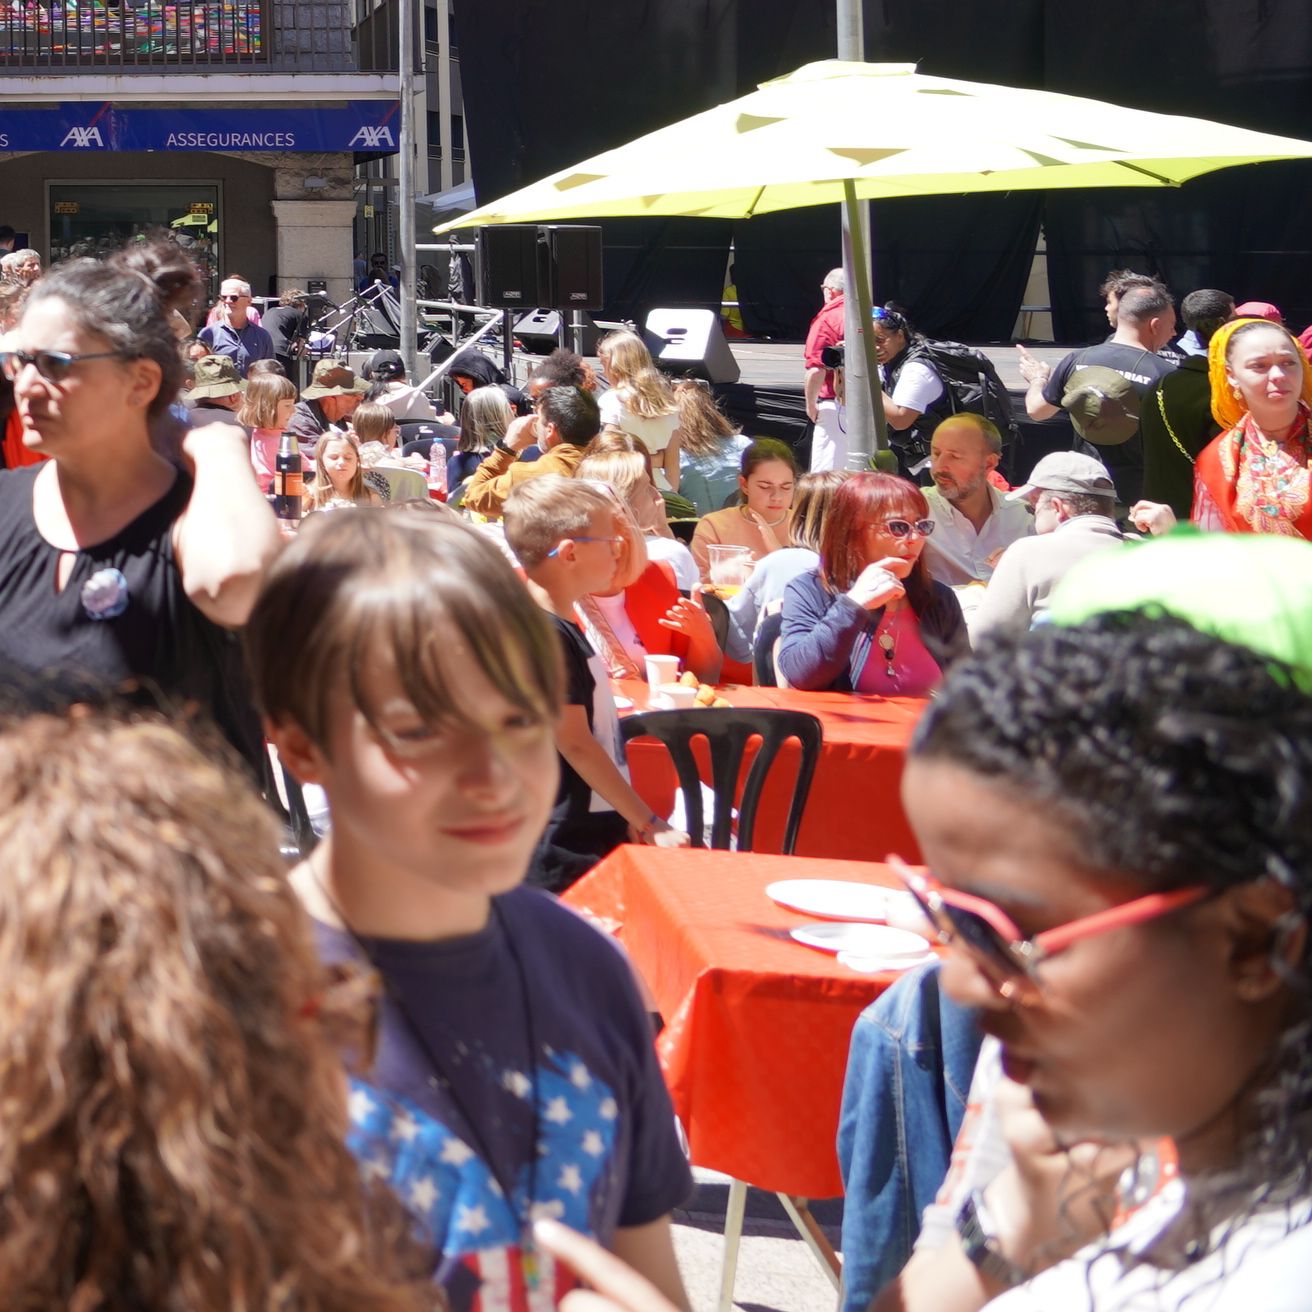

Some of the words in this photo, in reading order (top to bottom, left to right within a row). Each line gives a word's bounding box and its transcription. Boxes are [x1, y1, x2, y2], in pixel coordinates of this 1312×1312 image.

[60, 126, 104, 147] AXA
[167, 132, 295, 147] ASSEGURANCES
[348, 125, 395, 147] AXA
